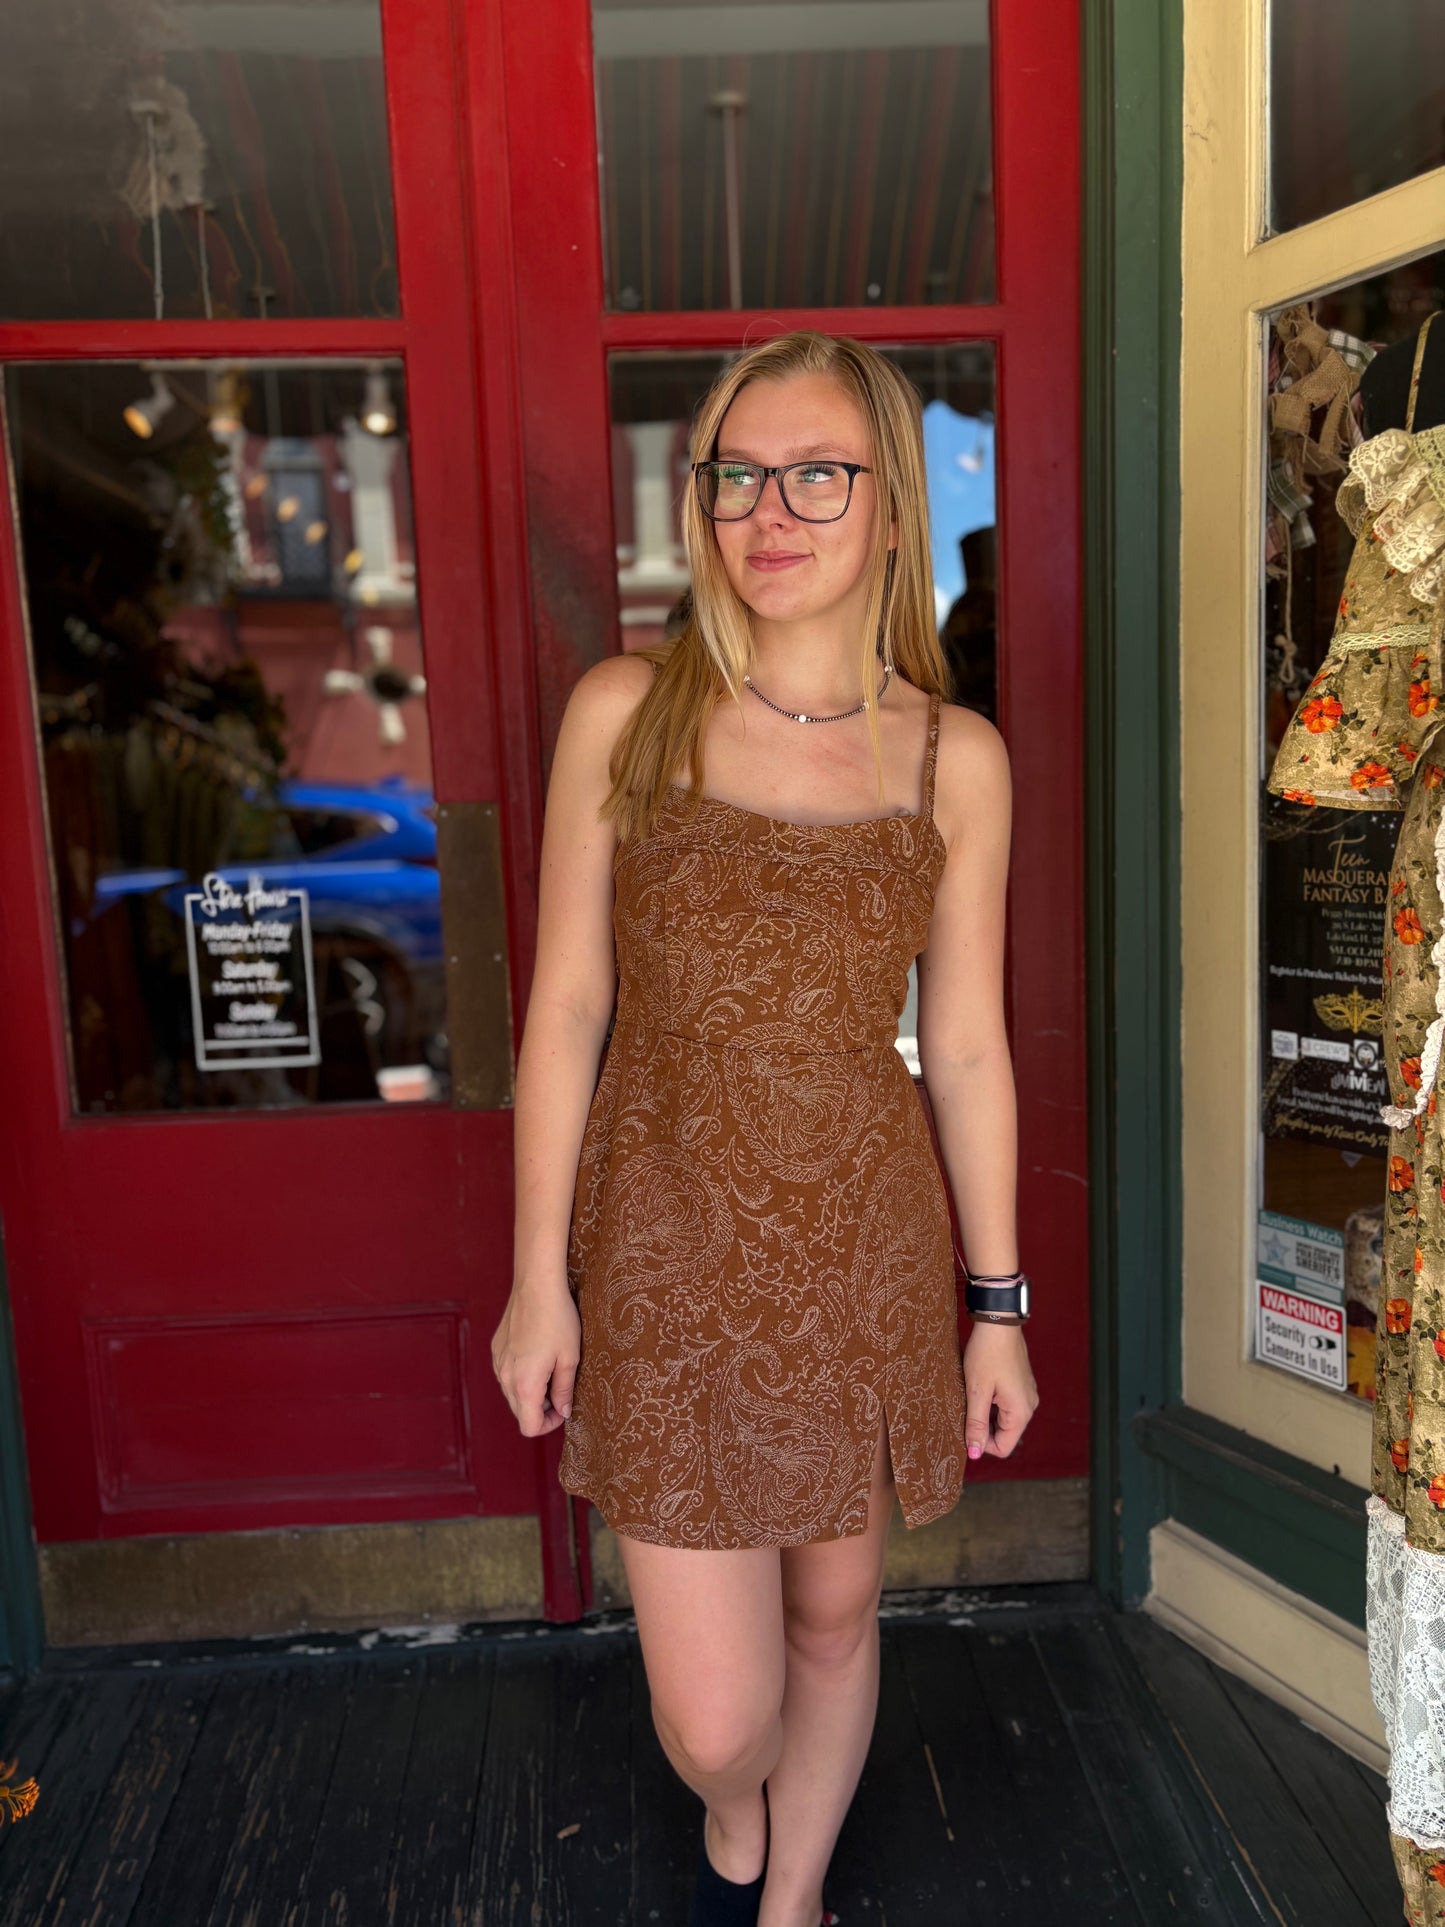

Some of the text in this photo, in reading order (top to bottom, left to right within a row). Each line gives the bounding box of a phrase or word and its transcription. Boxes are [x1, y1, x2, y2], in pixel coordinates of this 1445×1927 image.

[1328, 834, 1370, 883] Teen
[1303, 885, 1369, 904] FANTASY
[1260, 1211, 1342, 1247] Business Watch
[1262, 1288, 1339, 1331] WARNING
[1265, 1316, 1306, 1348] Security
[1265, 1337, 1338, 1379] Cameras In Use
